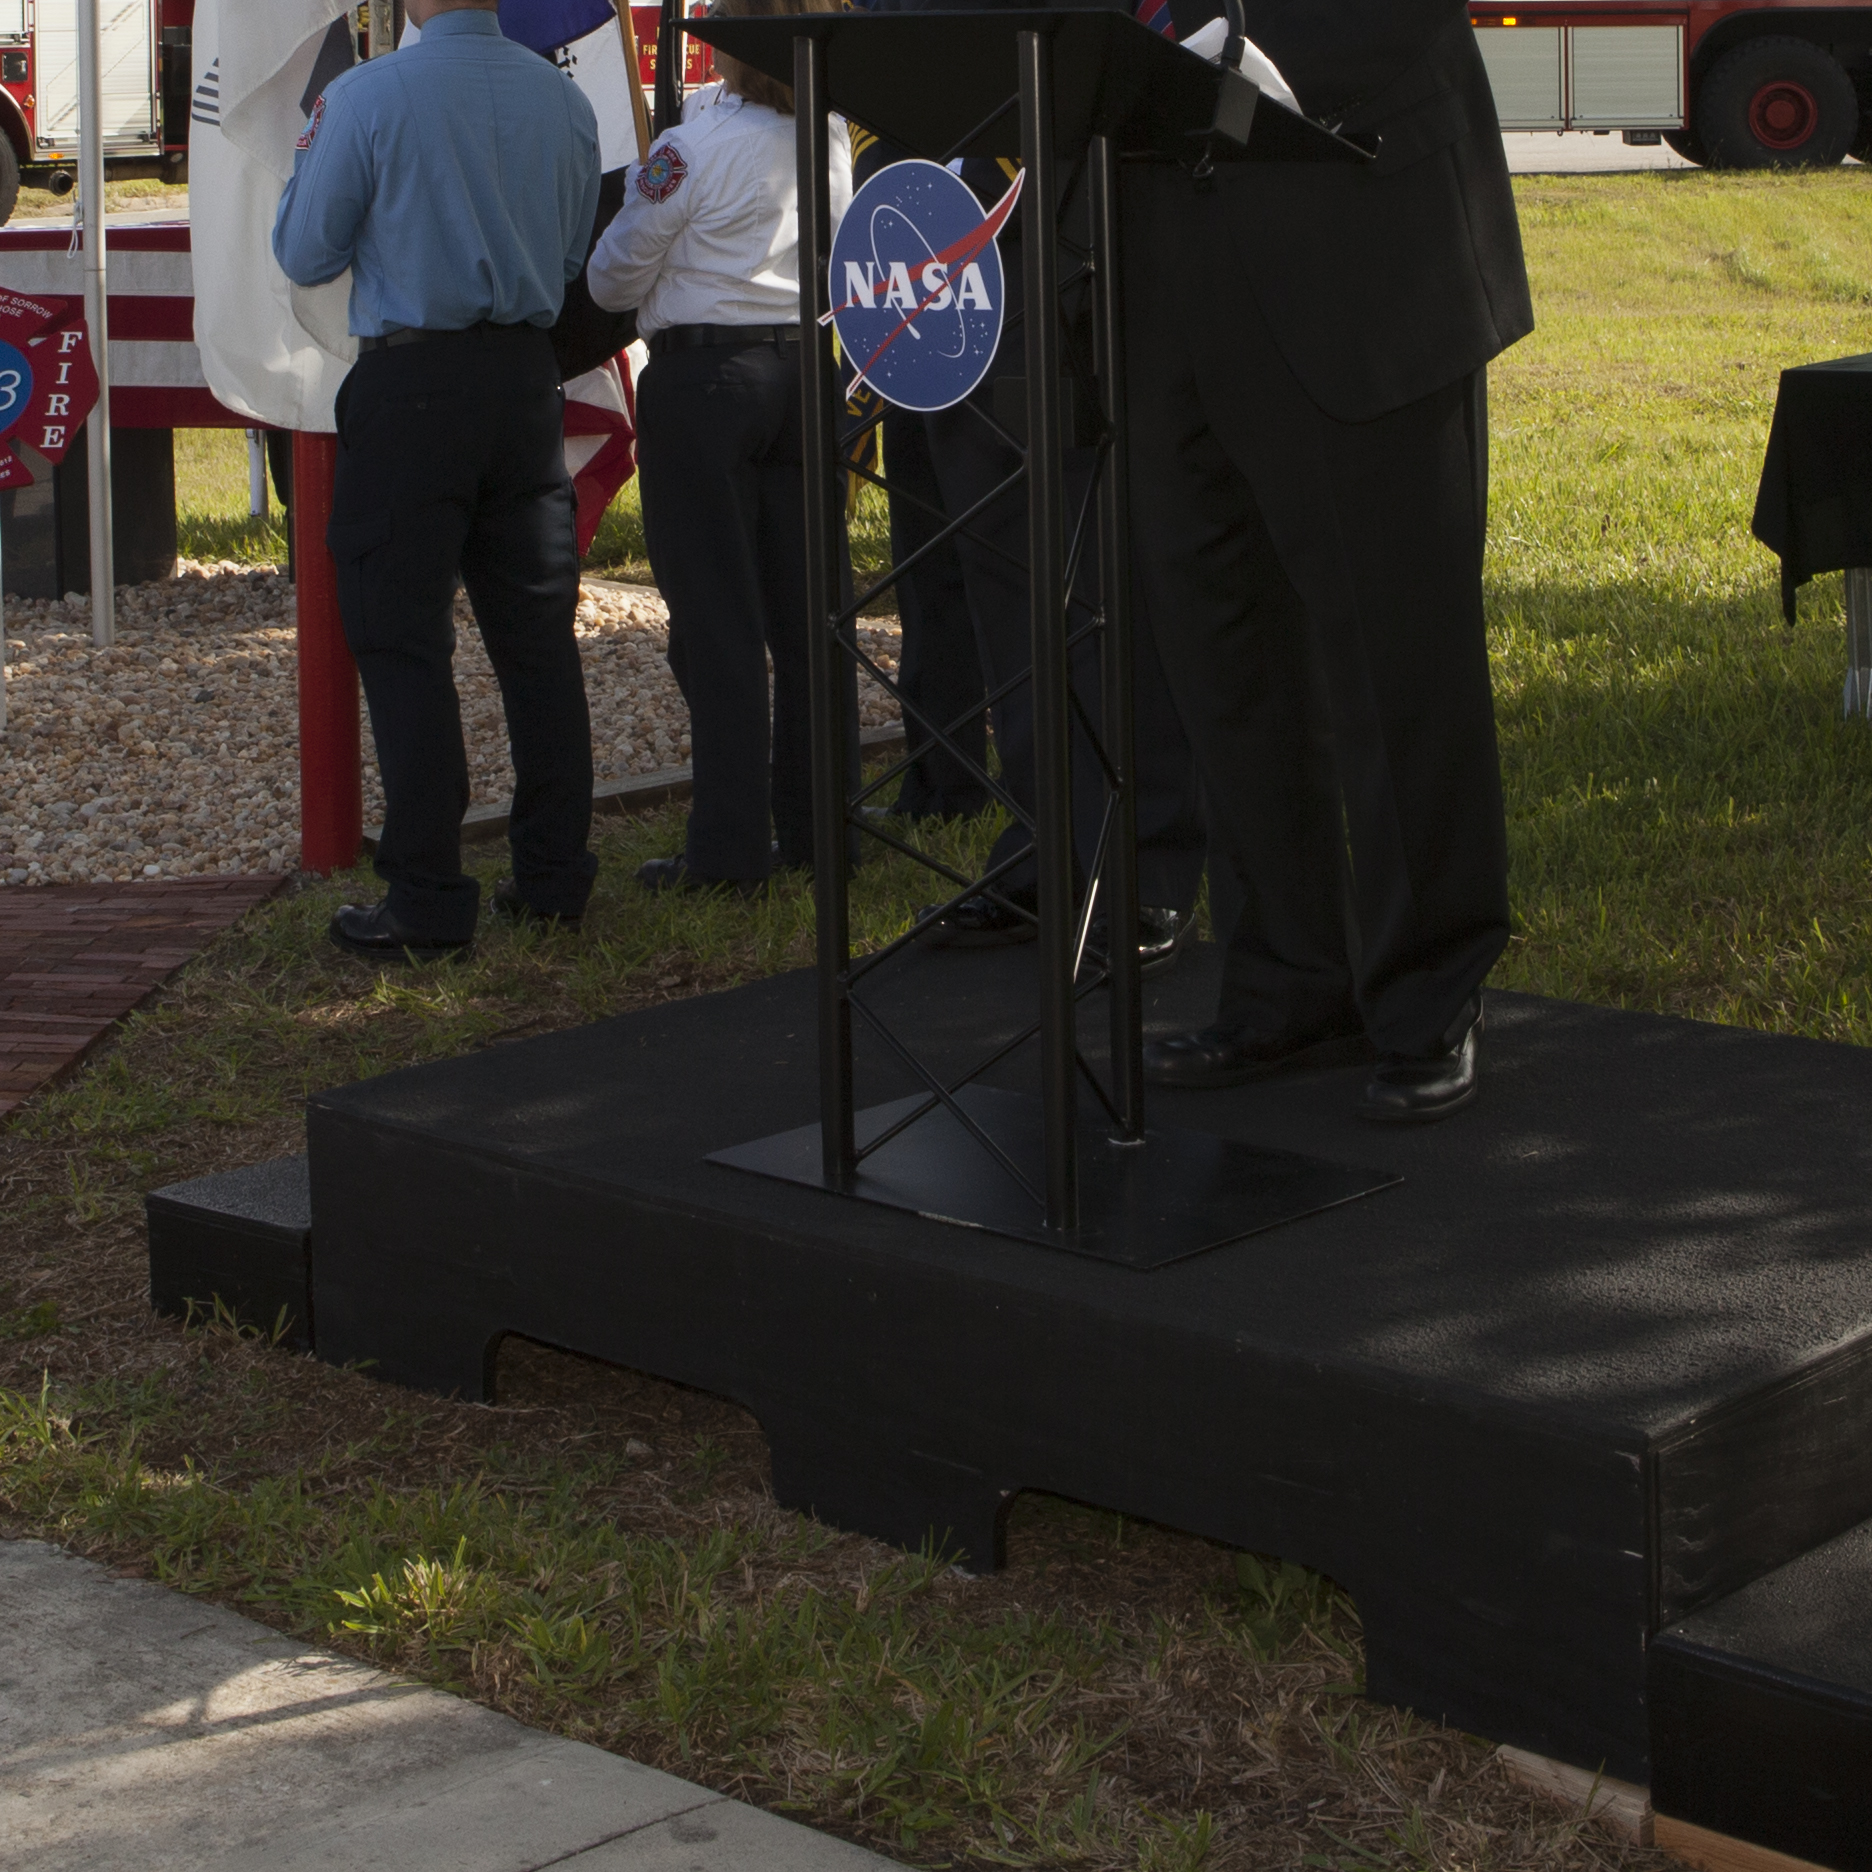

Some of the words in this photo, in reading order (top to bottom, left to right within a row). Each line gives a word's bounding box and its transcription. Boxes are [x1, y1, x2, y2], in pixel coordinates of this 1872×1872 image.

[10, 296, 53, 320] SORROW
[843, 261, 993, 311] NASA
[39, 331, 83, 448] FIRE
